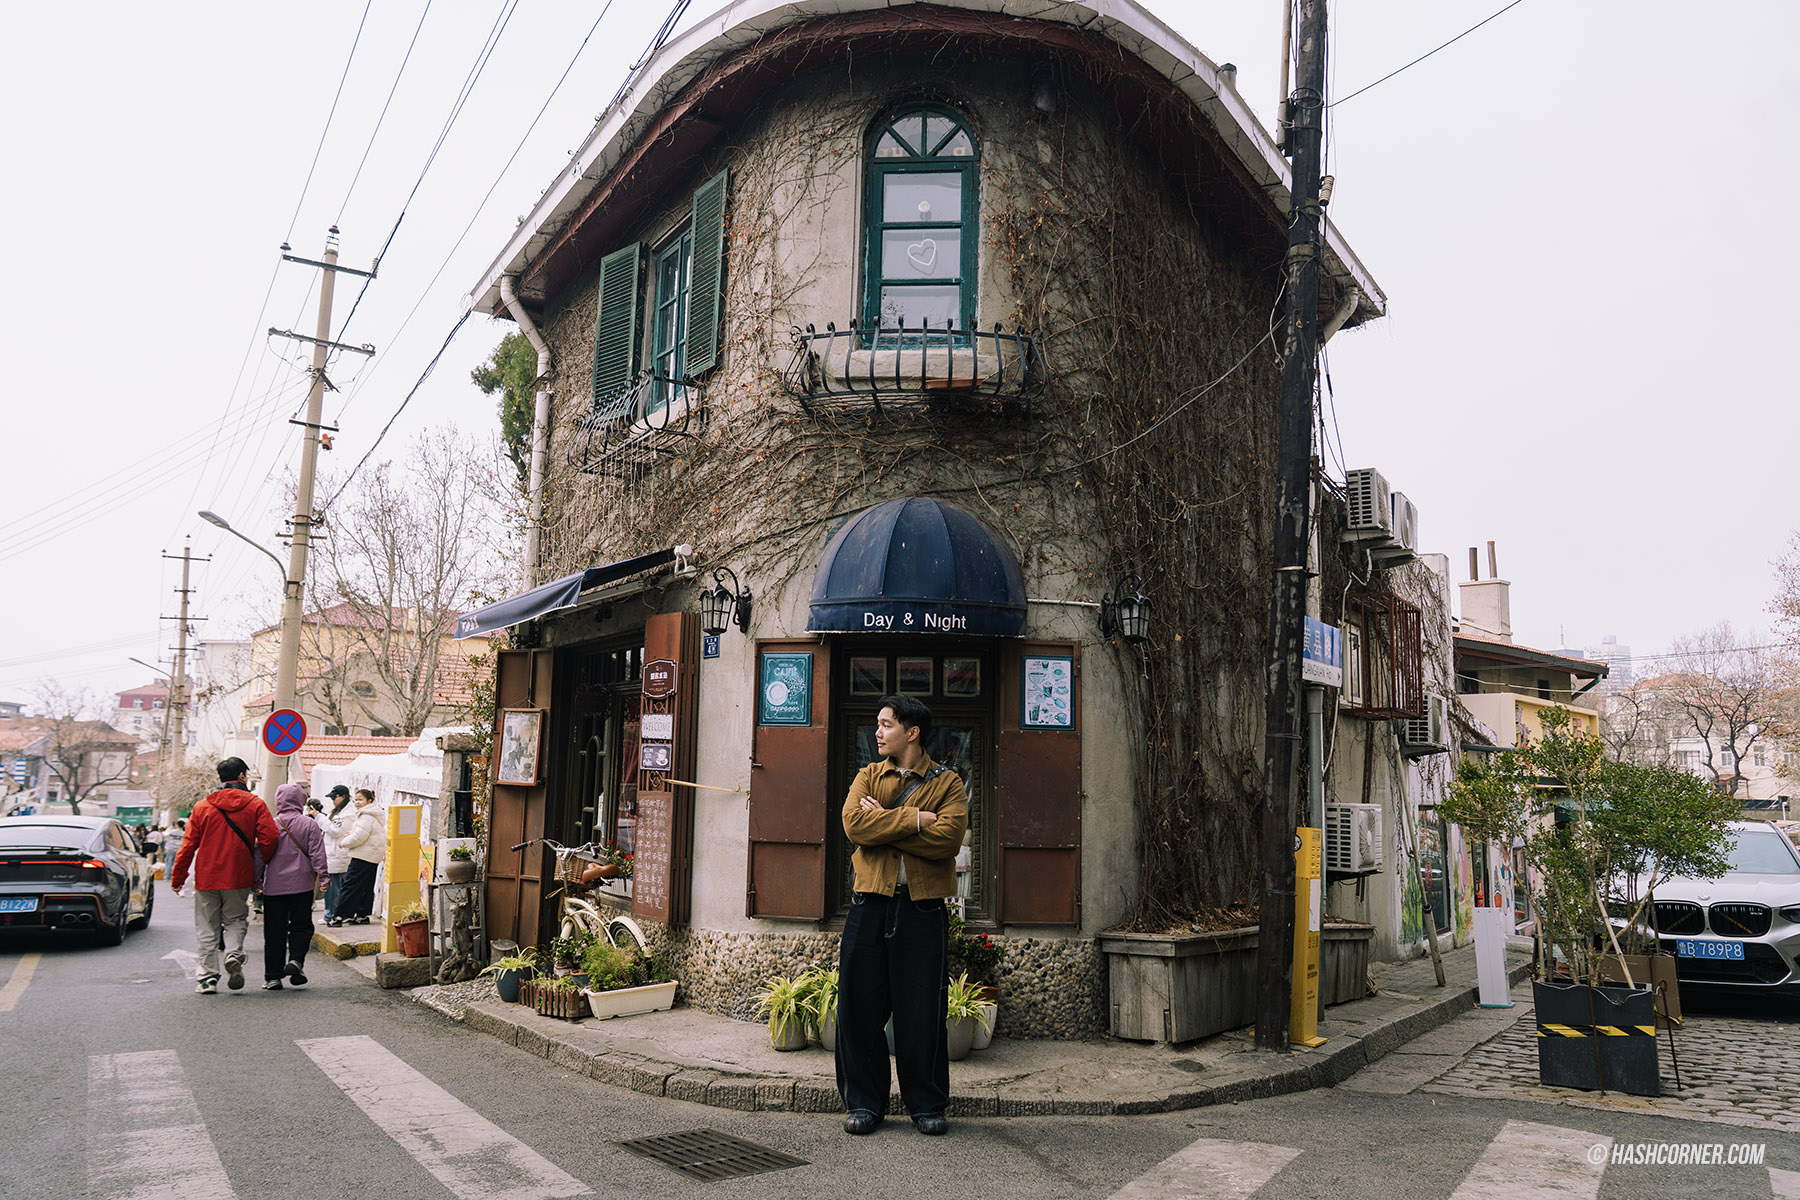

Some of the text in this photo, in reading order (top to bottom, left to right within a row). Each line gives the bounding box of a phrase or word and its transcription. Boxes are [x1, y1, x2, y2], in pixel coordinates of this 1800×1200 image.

[863, 612, 967, 631] Day & Night
[643, 721, 672, 732] WELCOME
